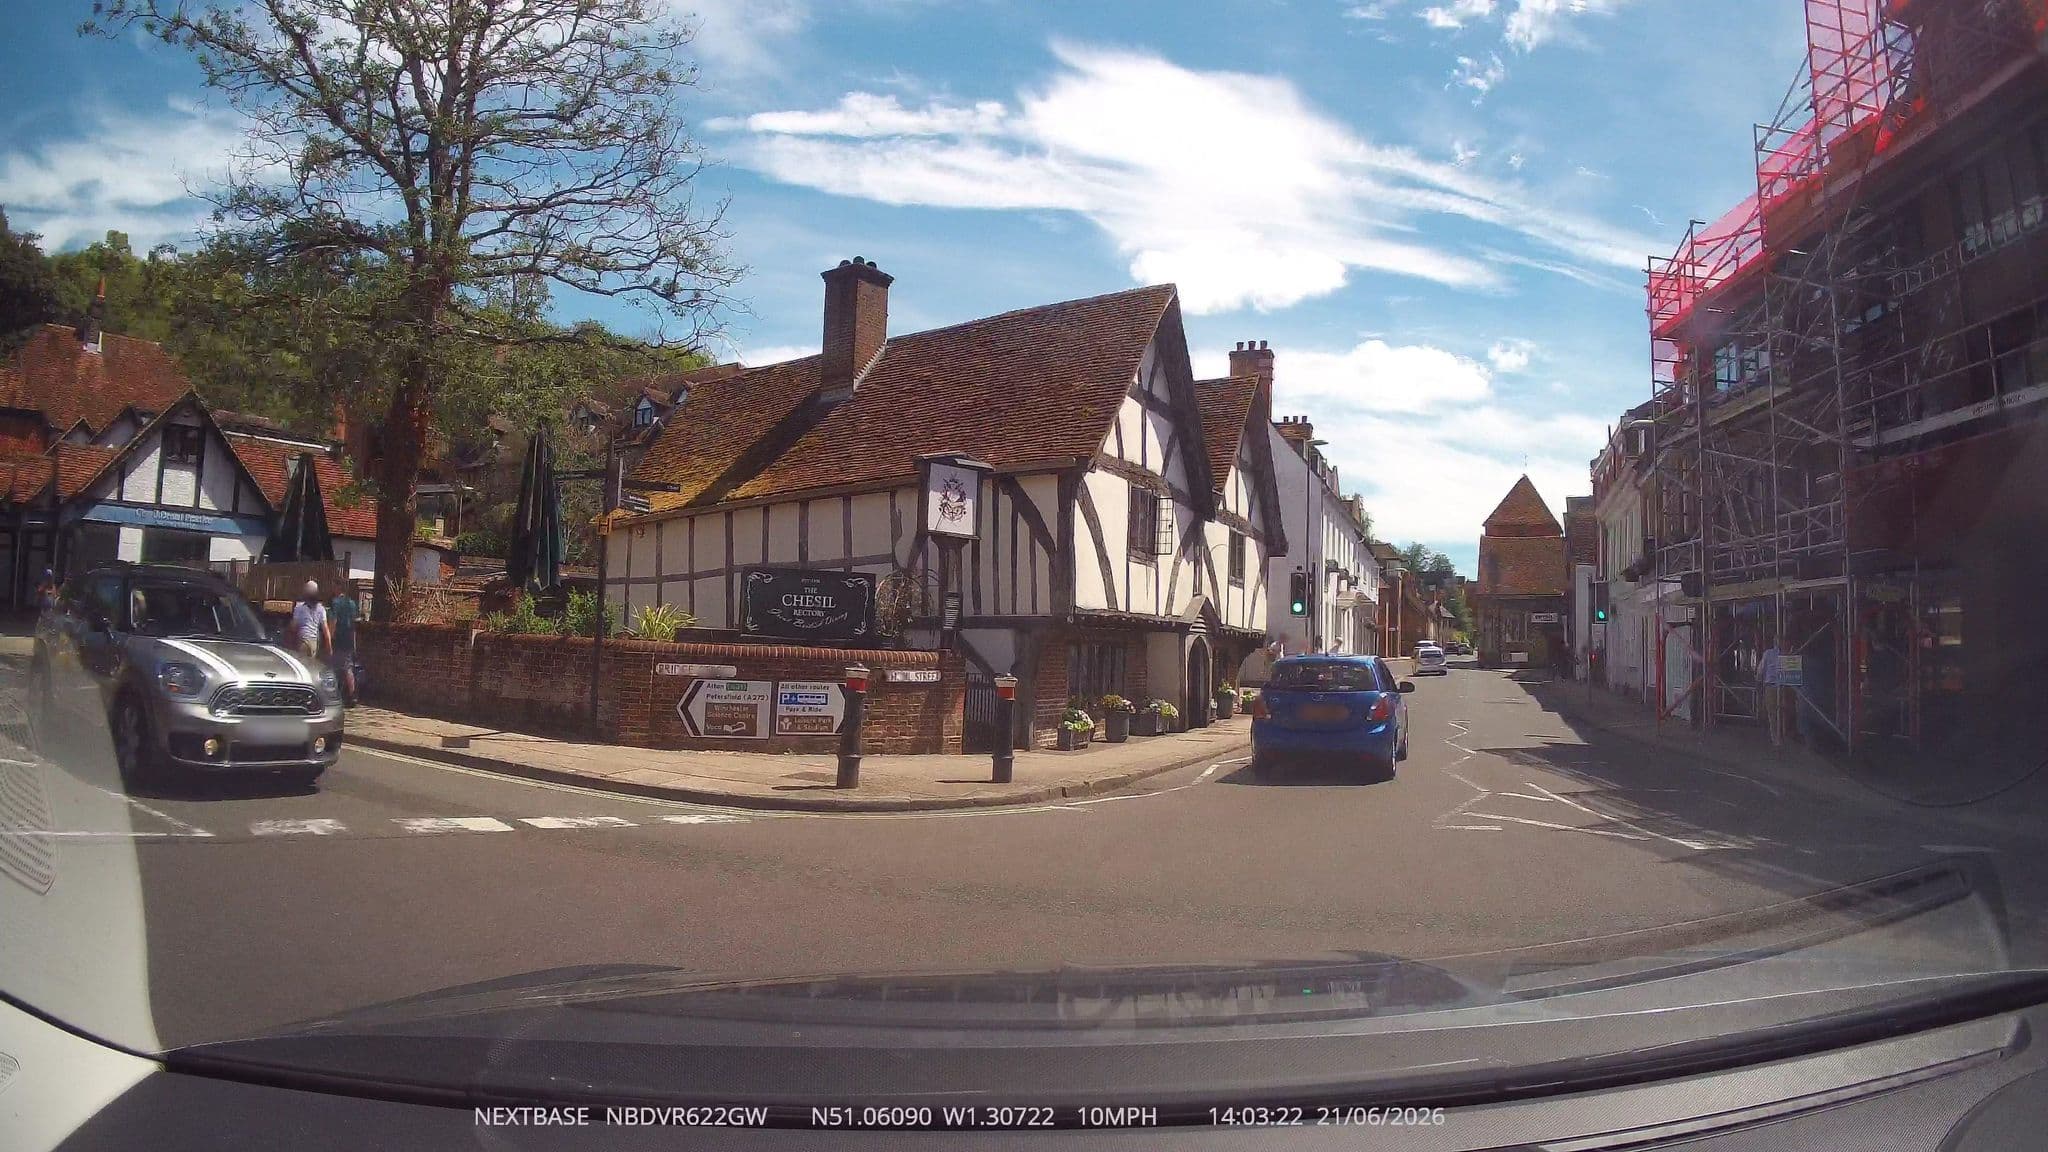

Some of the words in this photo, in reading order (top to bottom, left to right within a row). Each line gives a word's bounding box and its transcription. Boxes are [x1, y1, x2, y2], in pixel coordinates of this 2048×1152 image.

[782, 594, 837, 609] CHESIL
[793, 609, 826, 617] RECTORY
[706, 693, 742, 701] Petersfield
